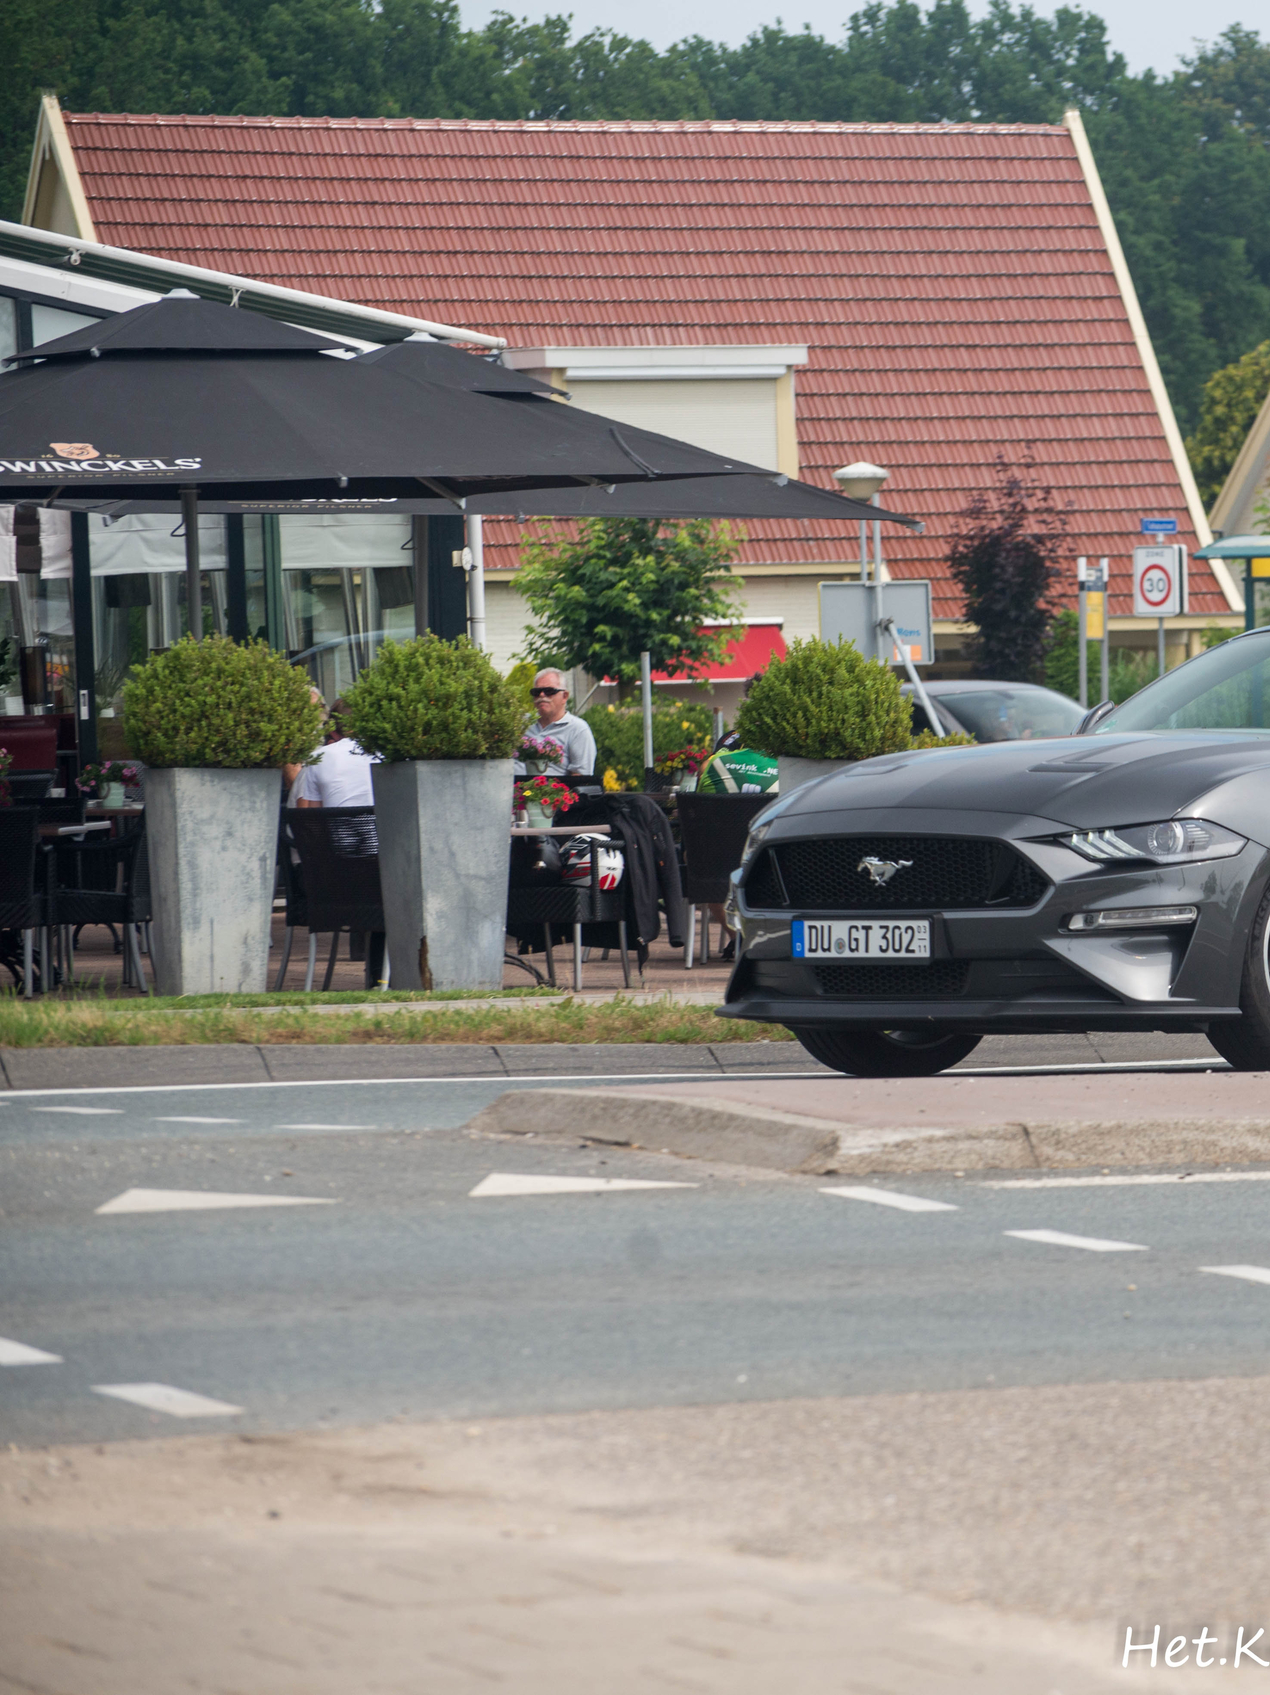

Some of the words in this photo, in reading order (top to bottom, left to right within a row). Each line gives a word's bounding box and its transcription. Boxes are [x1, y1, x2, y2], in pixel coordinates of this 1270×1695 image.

[0, 457, 202, 473] WINCKELS'
[1145, 577, 1166, 593] 30
[807, 924, 832, 954] DU
[848, 924, 873, 954] GT
[878, 924, 916, 954] 302
